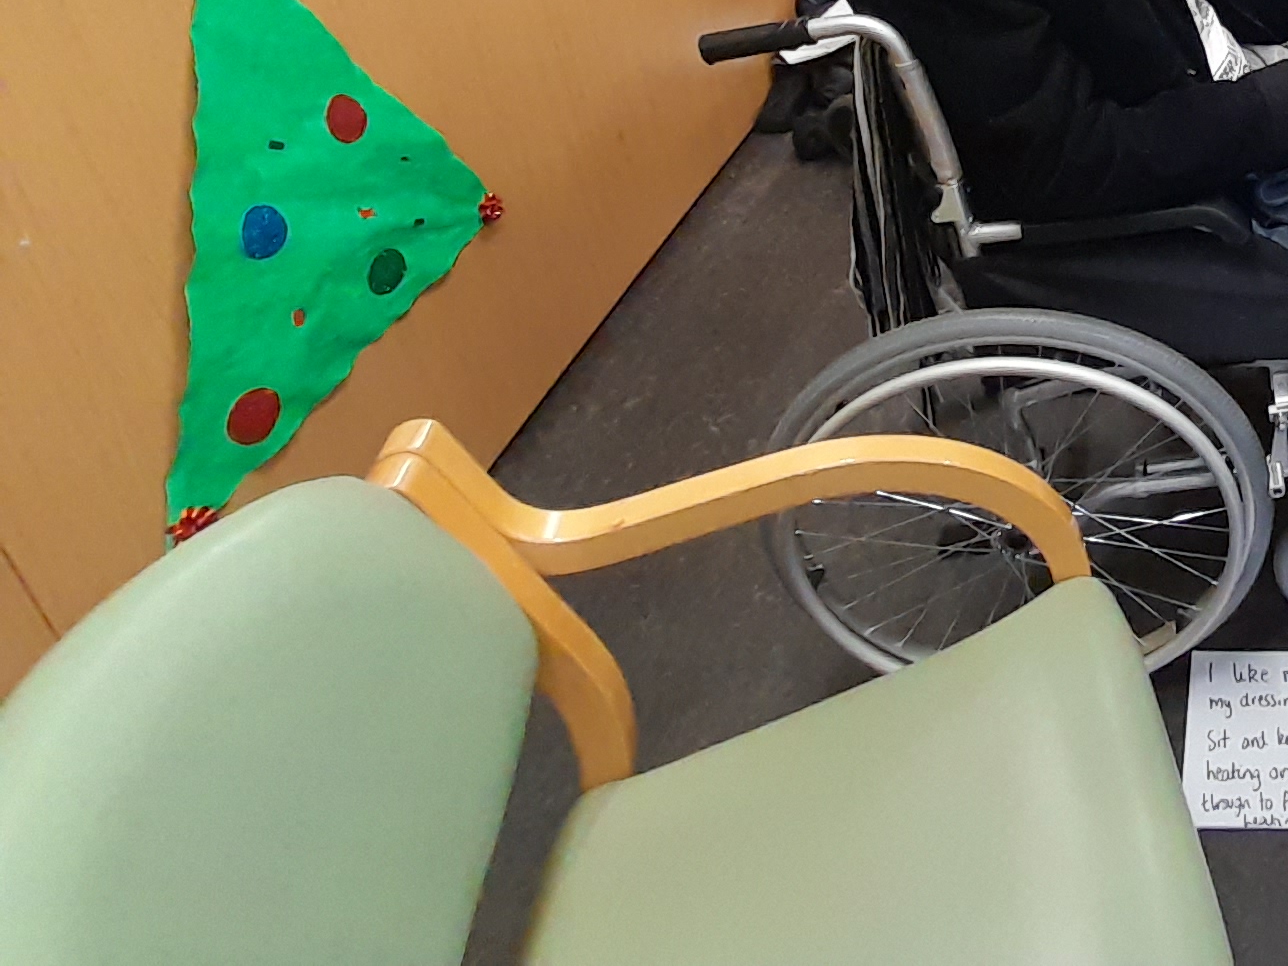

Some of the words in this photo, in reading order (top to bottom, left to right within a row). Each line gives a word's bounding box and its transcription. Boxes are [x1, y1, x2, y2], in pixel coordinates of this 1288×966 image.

[1233, 663, 1269, 683] like
[1208, 696, 1232, 718] my
[1207, 729, 1230, 750] Sit
[1241, 730, 1268, 750] and
[1206, 760, 1261, 791] heating
[1258, 791, 1273, 812] to
